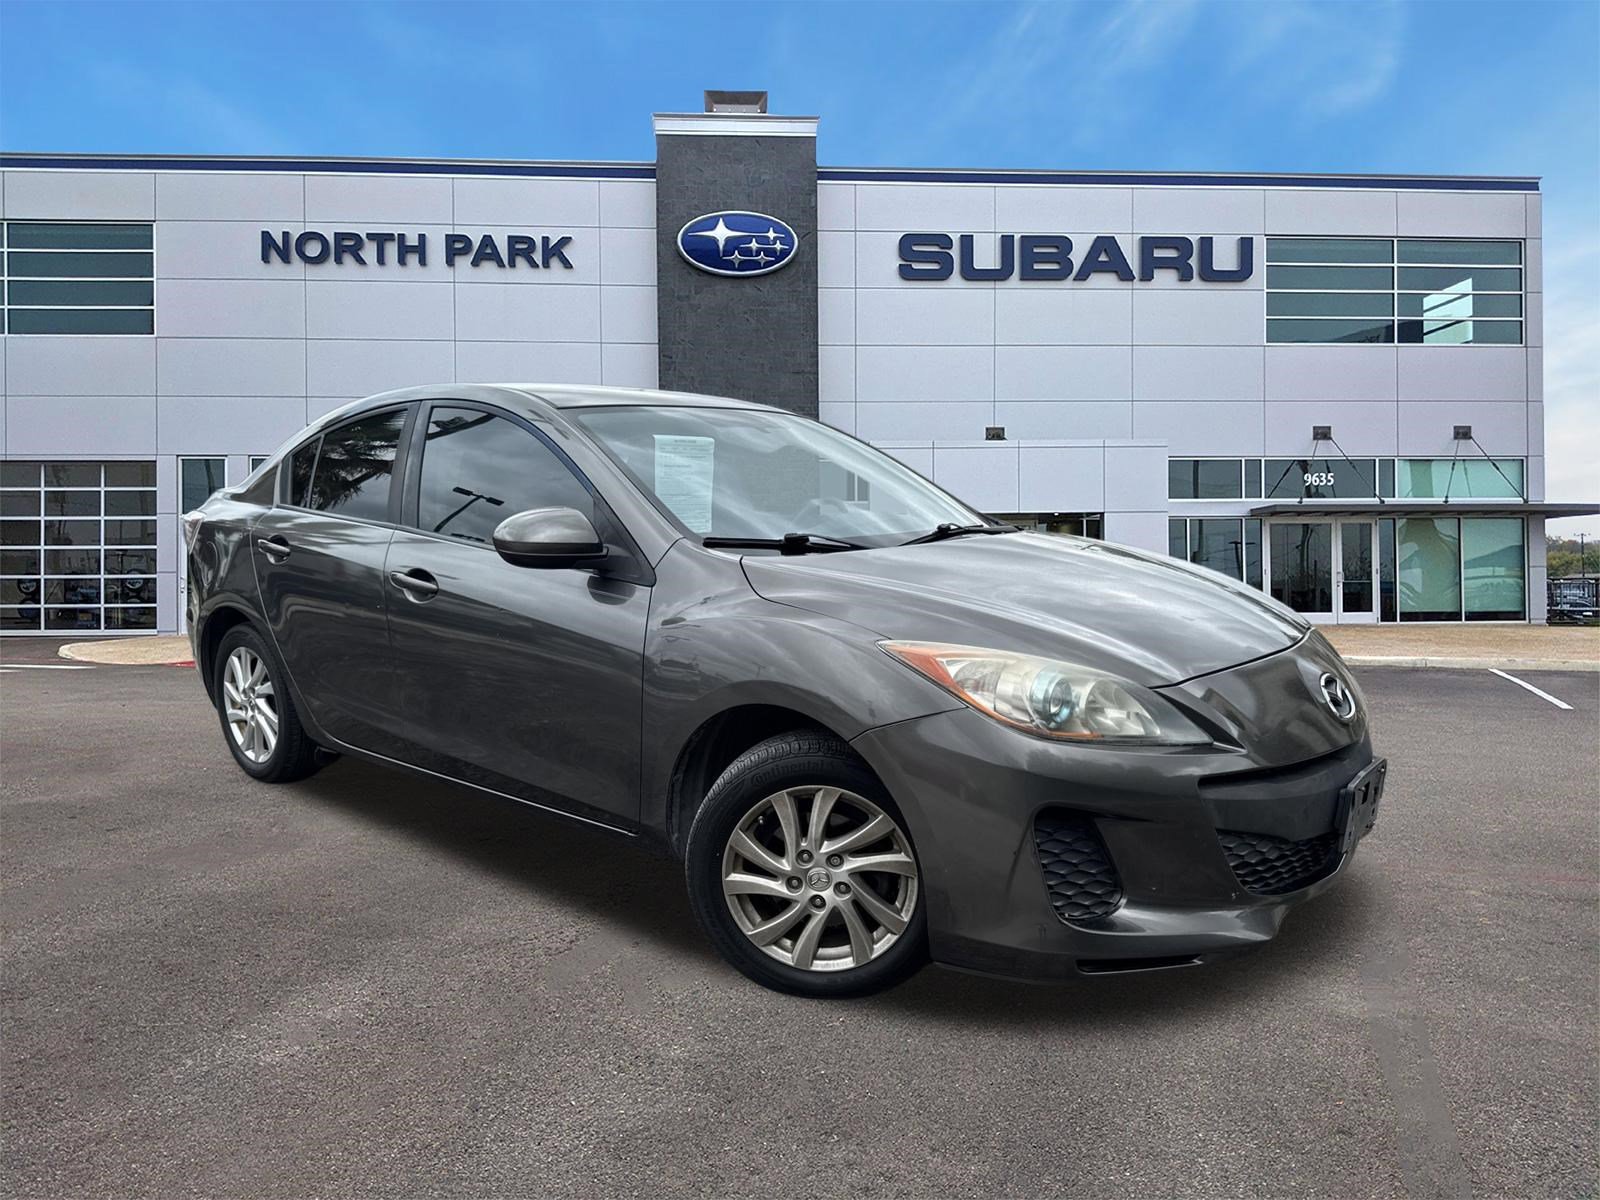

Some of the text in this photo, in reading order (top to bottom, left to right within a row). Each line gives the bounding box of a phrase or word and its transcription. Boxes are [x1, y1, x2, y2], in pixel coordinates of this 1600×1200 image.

[260, 230, 574, 269] NORTH PARK
[898, 232, 1254, 282] SUBARU
[1303, 472, 1335, 486] 9635
